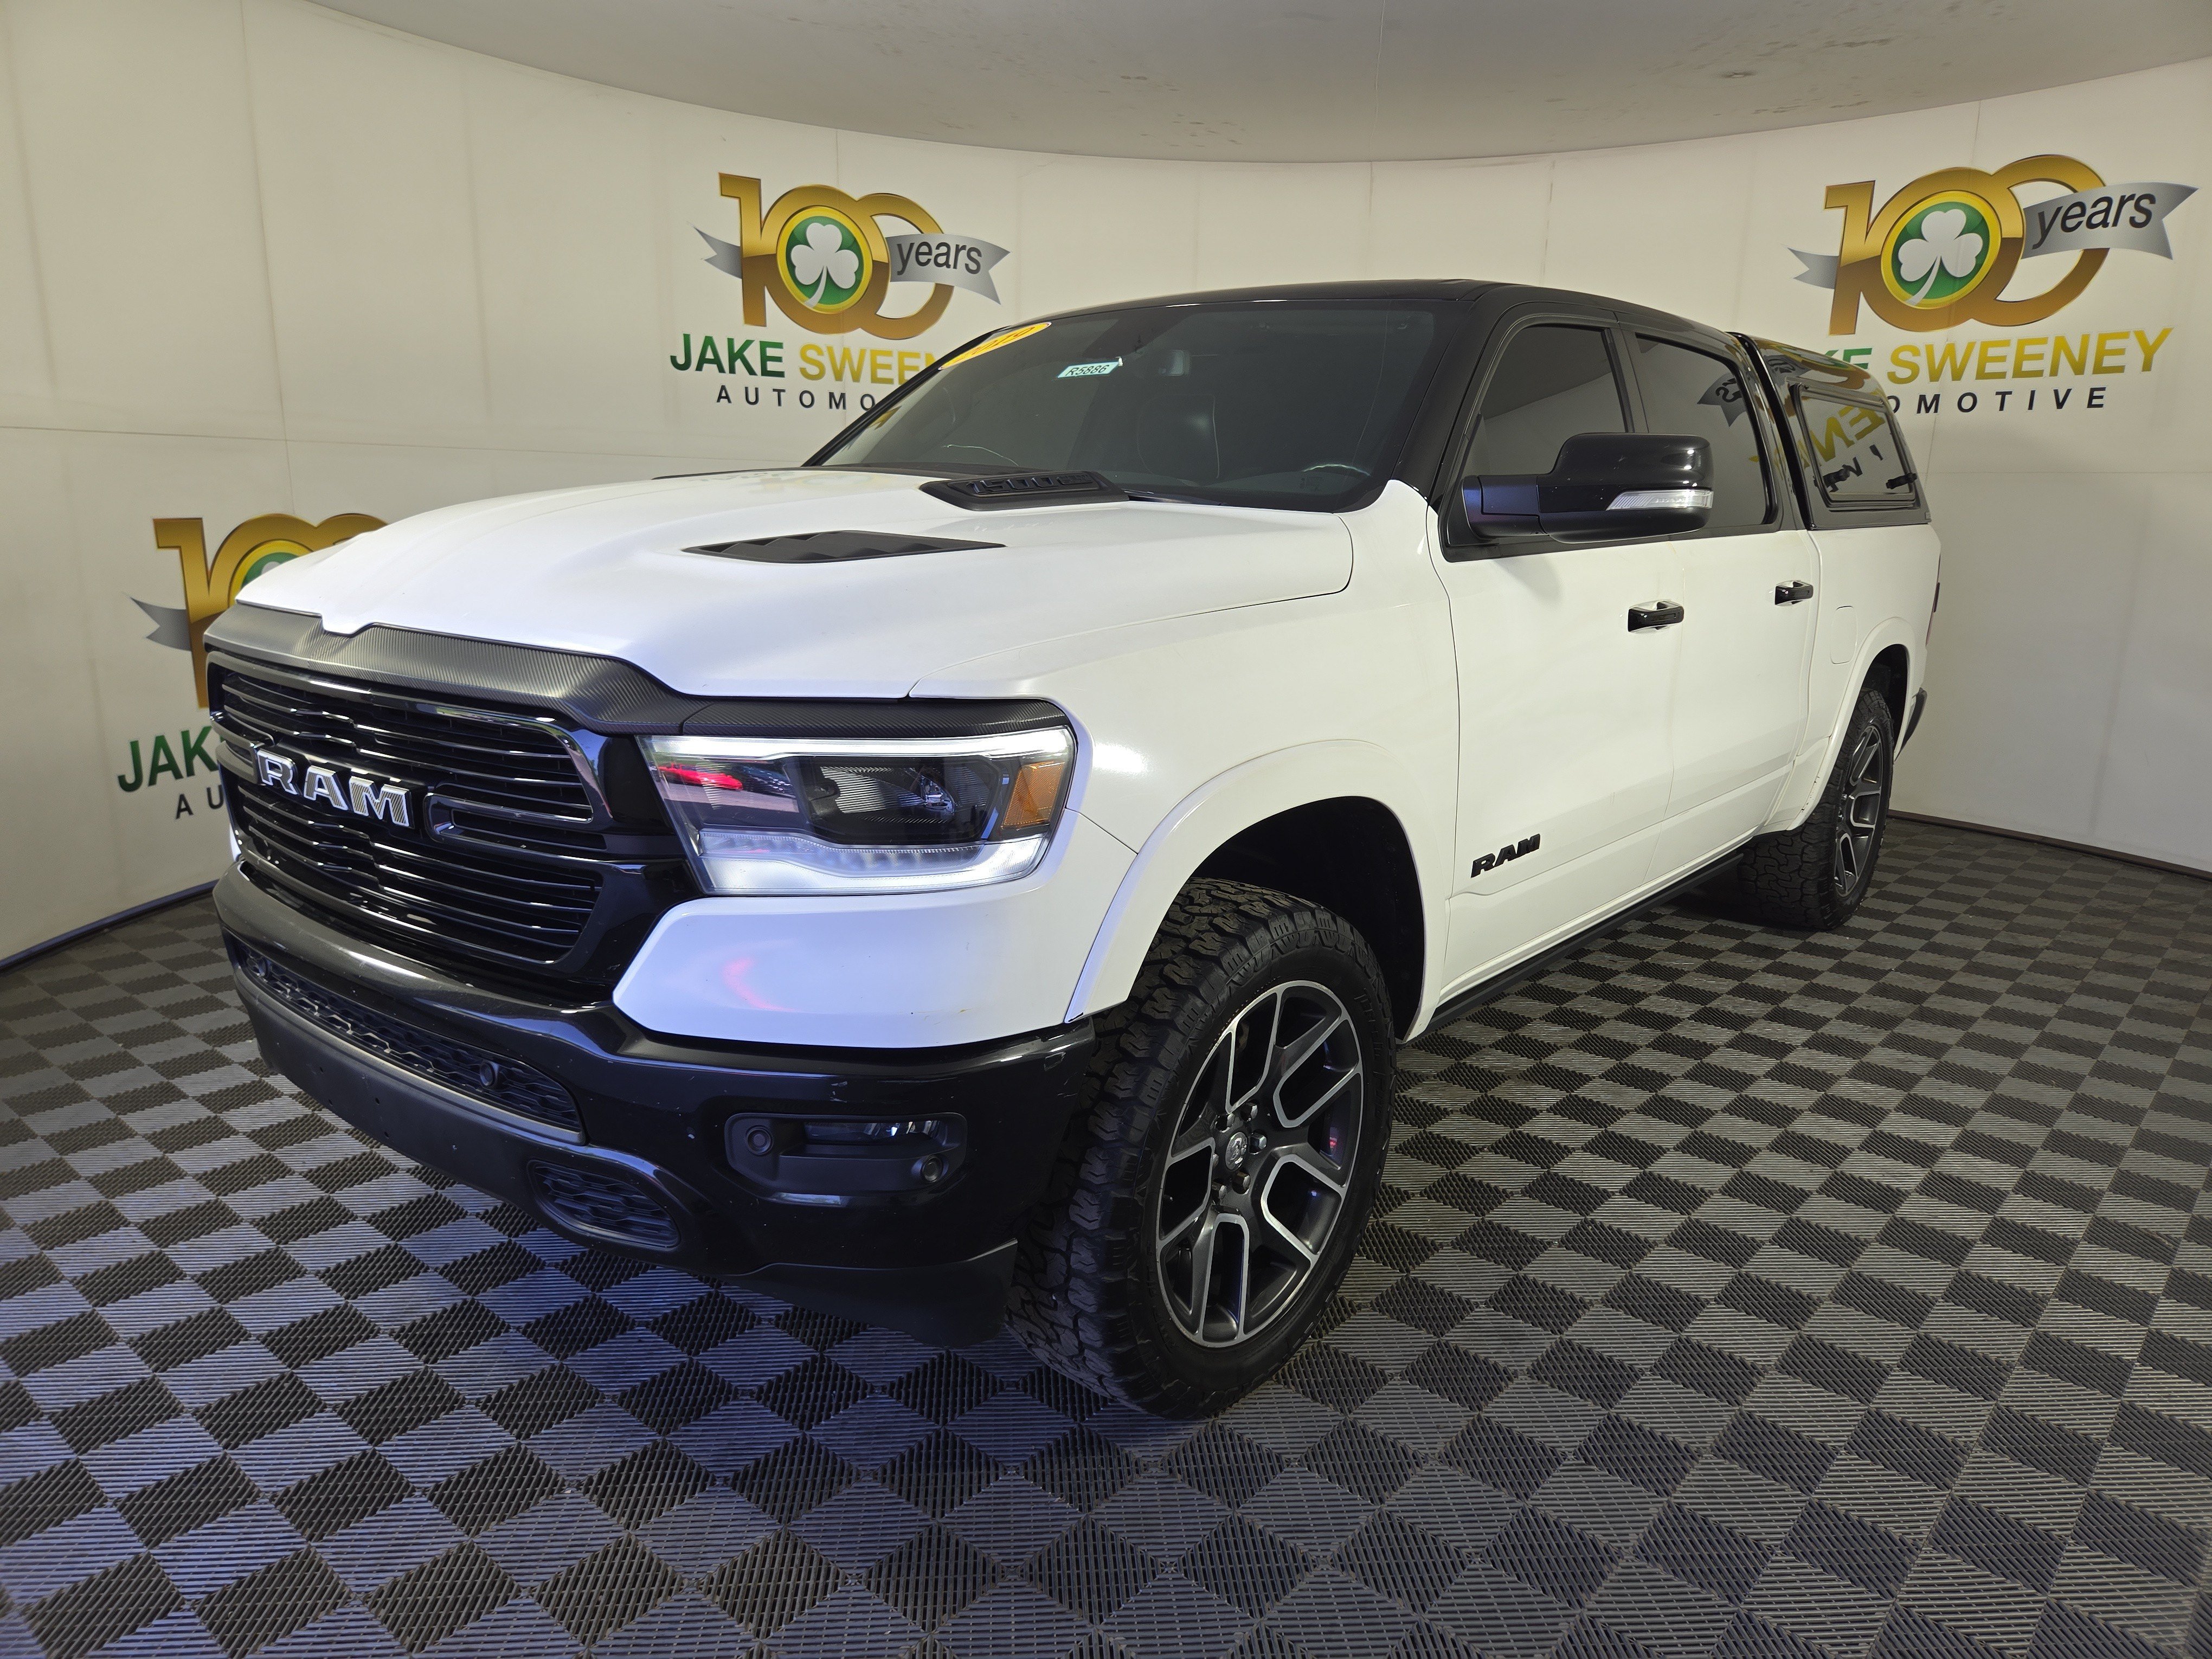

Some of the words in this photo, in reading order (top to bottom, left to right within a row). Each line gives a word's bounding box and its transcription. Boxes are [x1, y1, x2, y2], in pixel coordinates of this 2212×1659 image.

[2031, 192, 2157, 249] years
[896, 241, 982, 275] years
[670, 332, 786, 378] JAKE
[1065, 364, 1110, 376] R5886
[1887, 327, 2175, 385] SWEENEY
[118, 725, 224, 792] JAK
[257, 749, 410, 827] RAM
[1470, 833, 1541, 878] RAM
